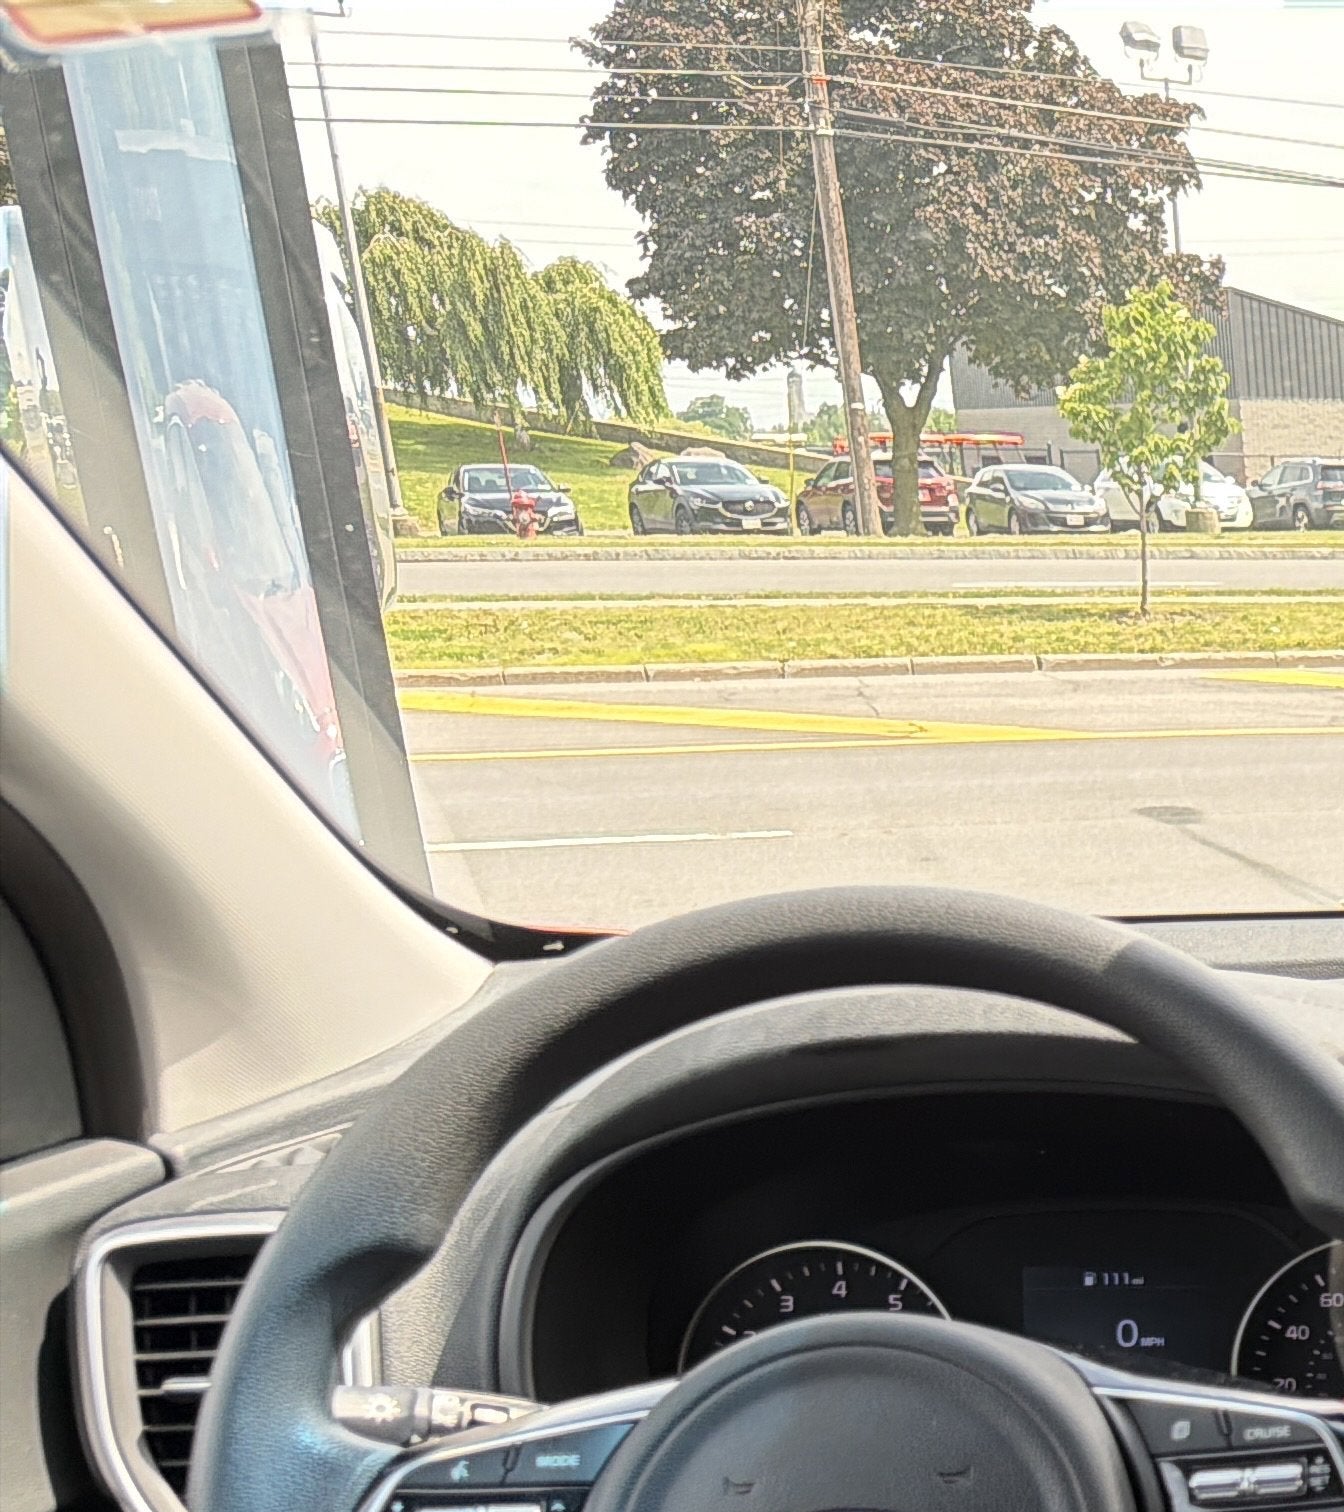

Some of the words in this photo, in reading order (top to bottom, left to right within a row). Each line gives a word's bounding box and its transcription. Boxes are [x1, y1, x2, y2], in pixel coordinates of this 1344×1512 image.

[1102, 1272, 1130, 1286] 111
[831, 1280, 848, 1298] 4
[779, 1294, 795, 1313] 3
[887, 1293, 903, 1312] 5
[1319, 1292, 1344, 1308] 60
[1115, 1319, 1139, 1348] 0
[1140, 1336, 1165, 1347] MPH
[1284, 1325, 1310, 1341] 40
[1244, 1424, 1292, 1441] CRUISE
[534, 1453, 581, 1468] MODE
